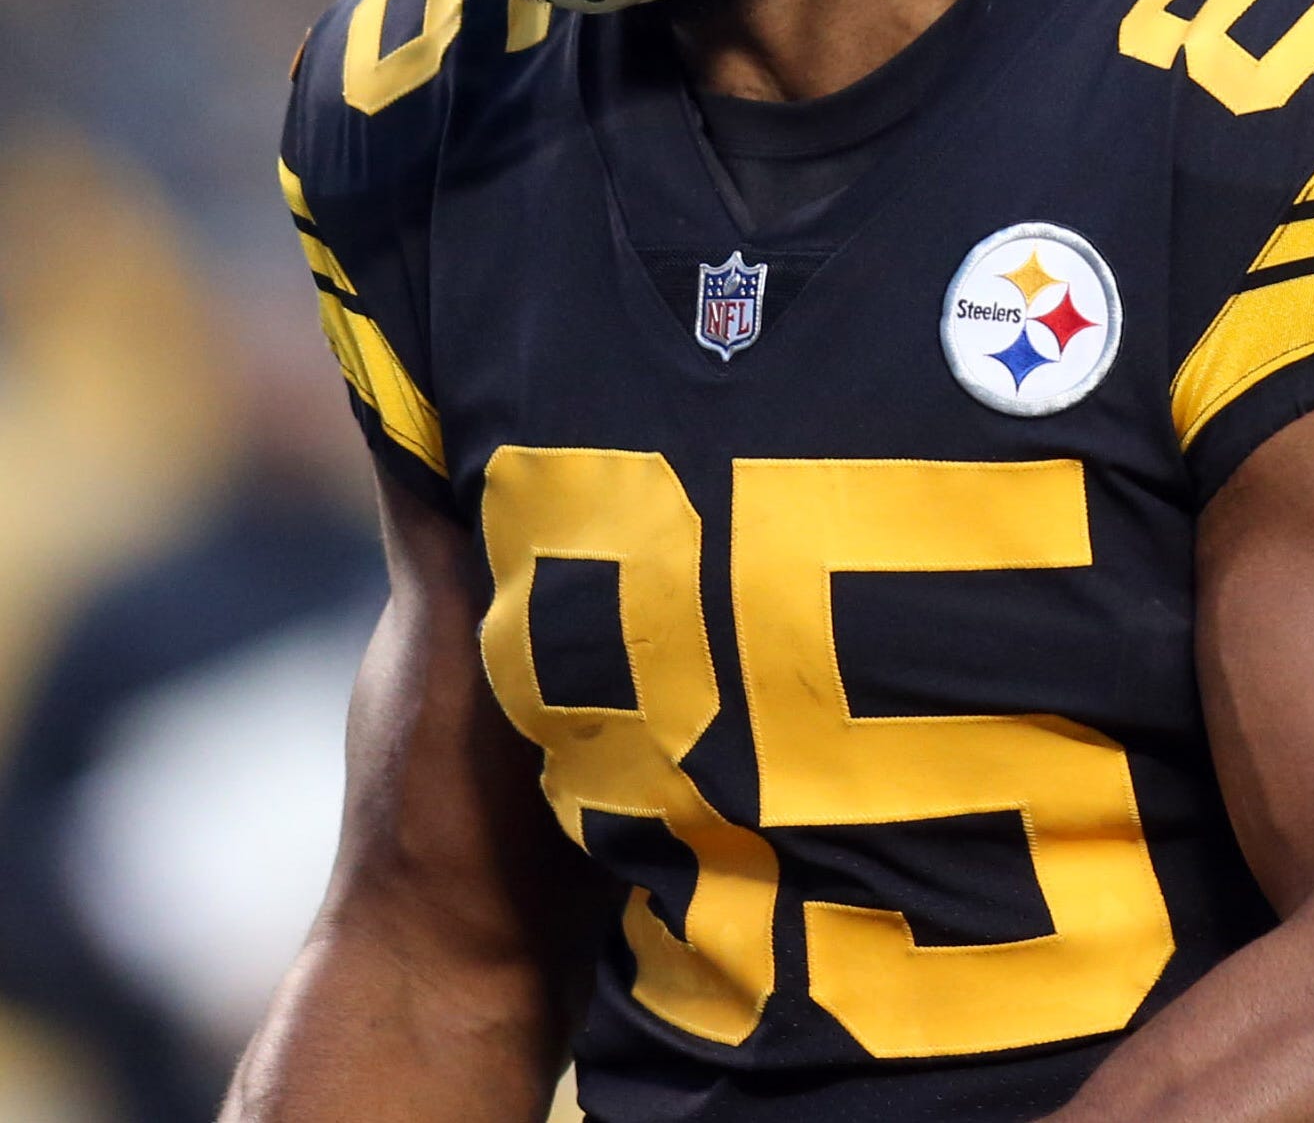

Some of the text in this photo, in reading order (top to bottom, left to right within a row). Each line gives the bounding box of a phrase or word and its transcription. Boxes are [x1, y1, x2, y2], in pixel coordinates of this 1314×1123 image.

[706, 301, 750, 341] NFL
[956, 298, 1022, 324] Steelers
[480, 444, 1177, 1059] 85
